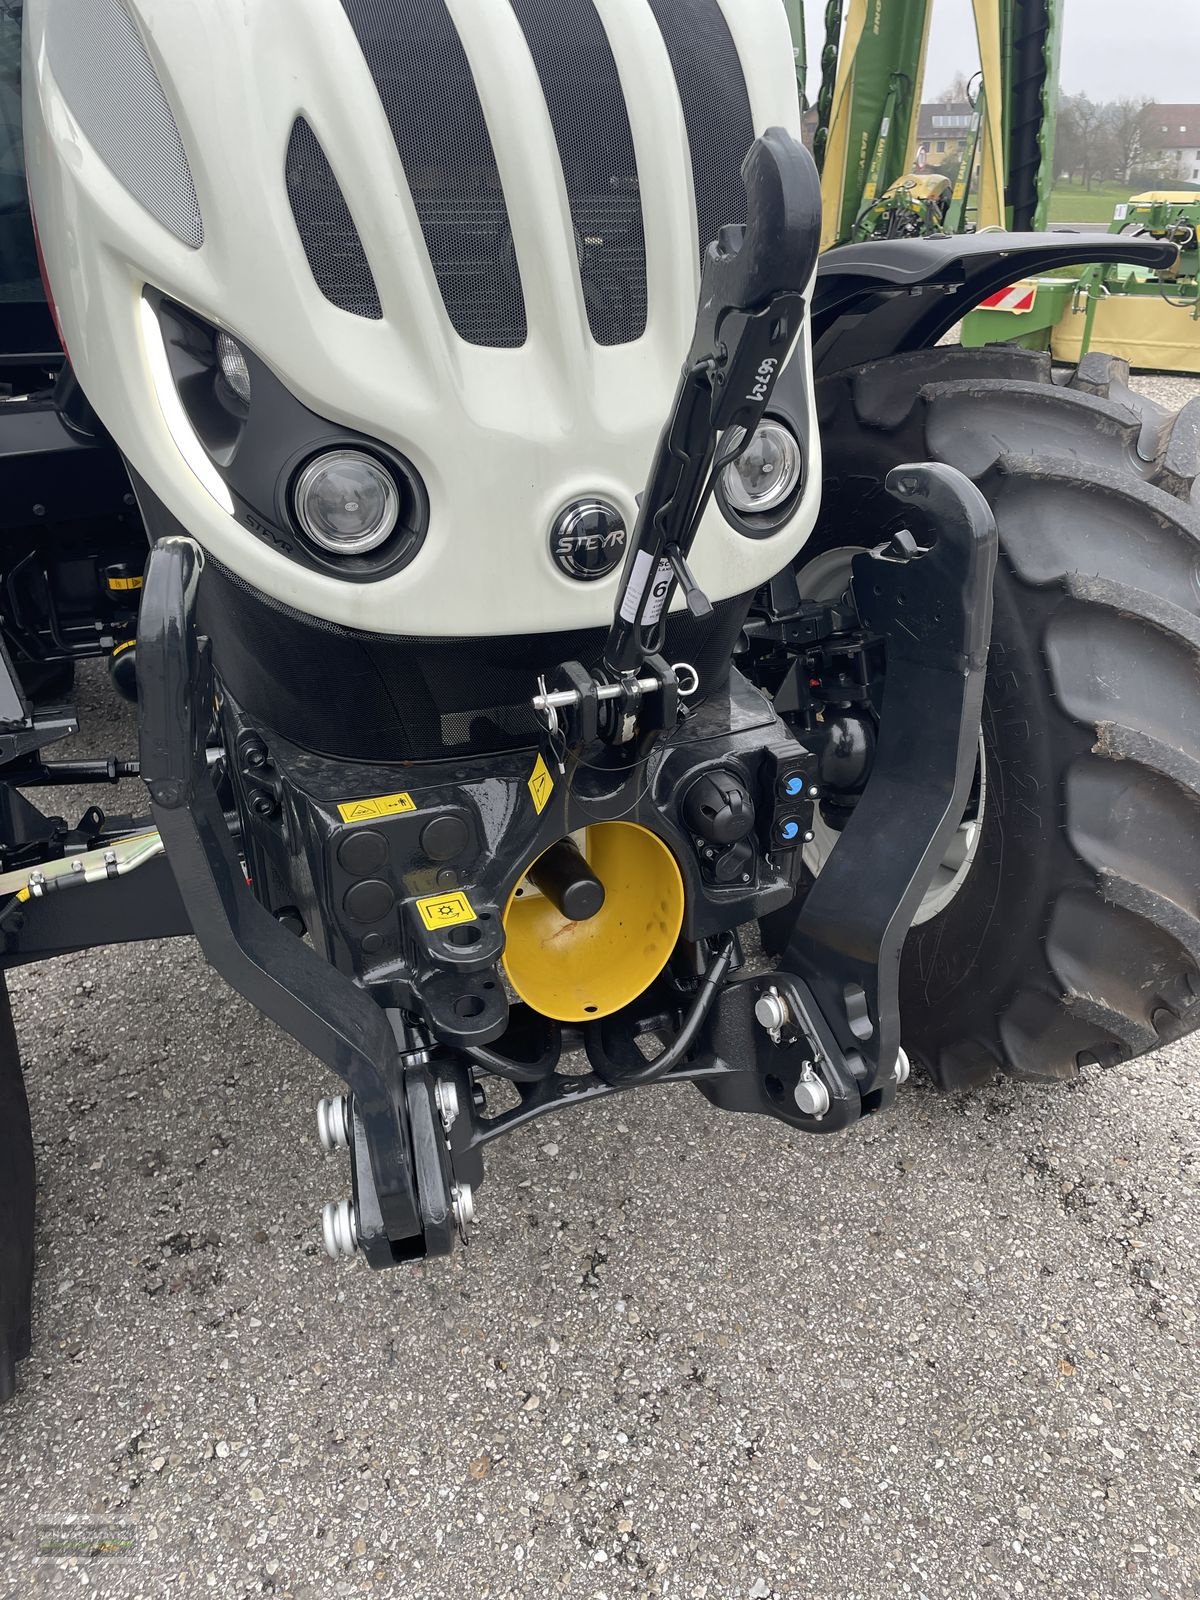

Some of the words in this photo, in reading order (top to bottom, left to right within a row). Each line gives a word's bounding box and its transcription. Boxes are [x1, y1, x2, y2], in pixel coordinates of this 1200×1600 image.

[745, 358, 778, 401] 66721
[244, 513, 294, 554] STEYR
[555, 529, 625, 555] STEYR
